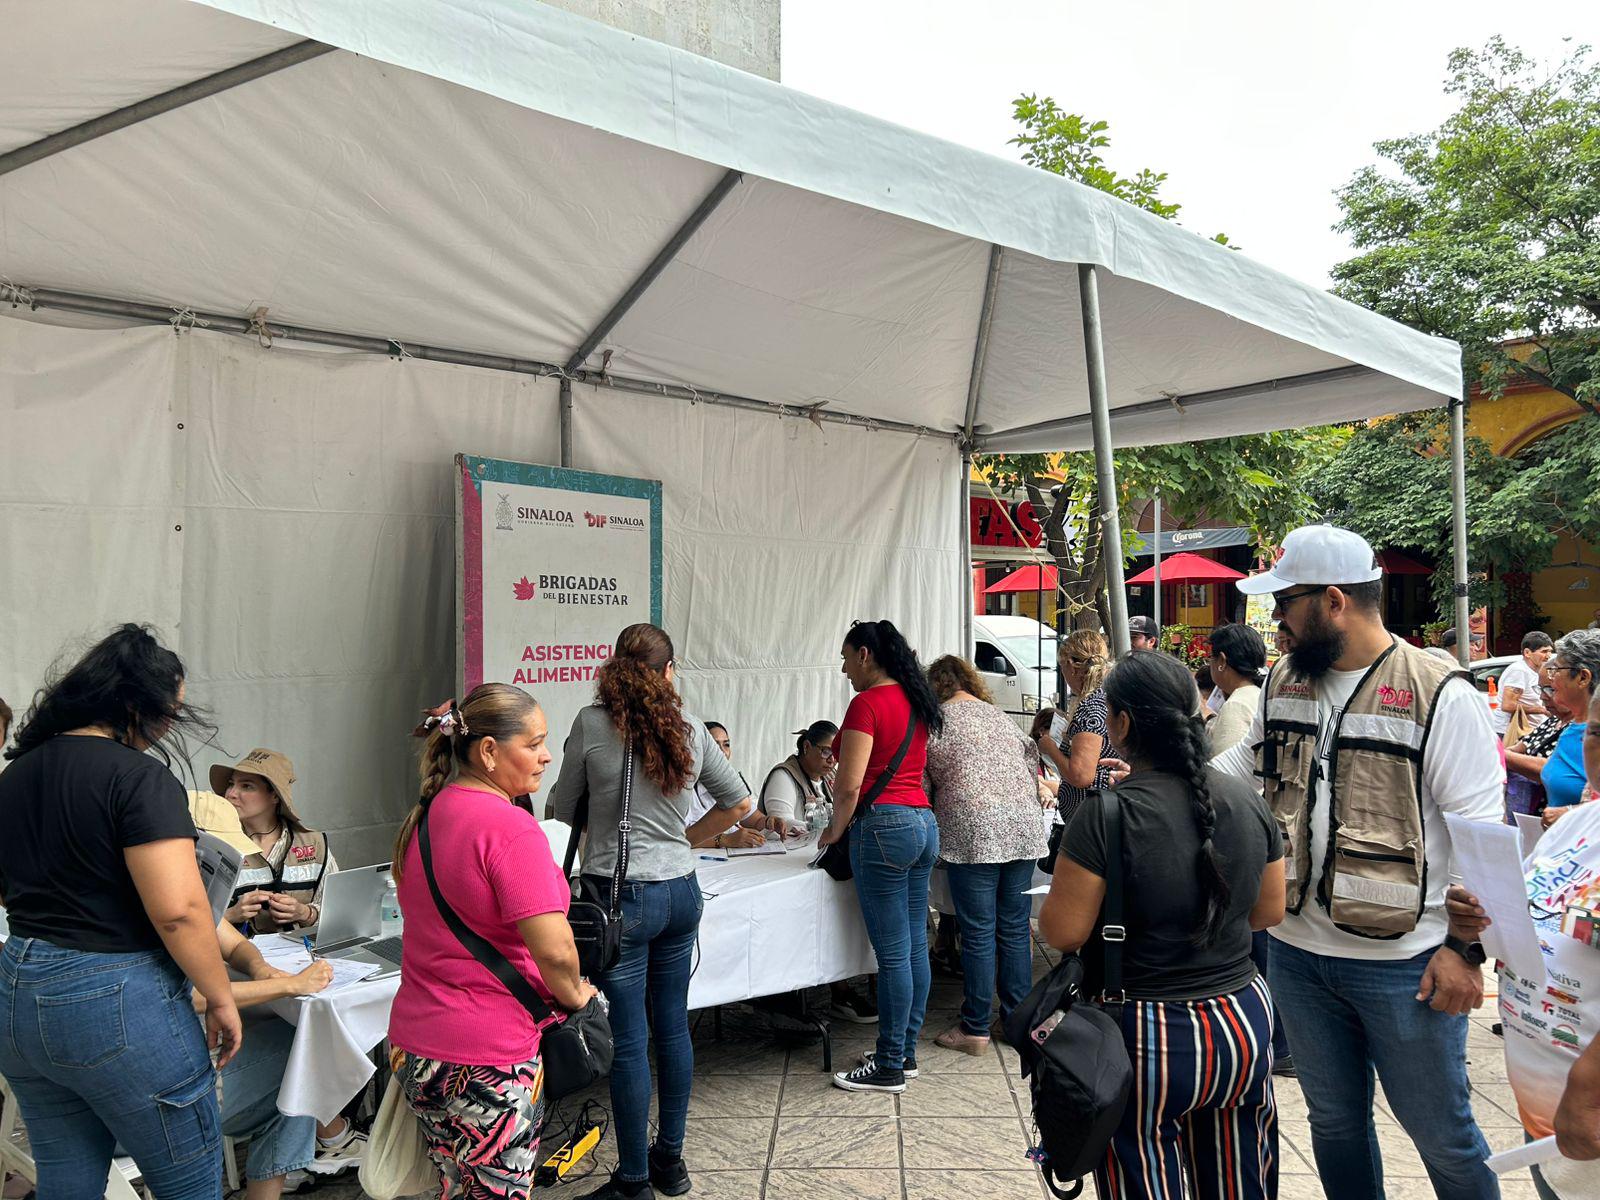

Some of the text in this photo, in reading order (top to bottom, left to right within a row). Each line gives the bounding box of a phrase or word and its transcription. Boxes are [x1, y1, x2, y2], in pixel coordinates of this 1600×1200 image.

[517, 506, 574, 523] SINALOA
[587, 514, 645, 528] DIF SINALOA
[1172, 531, 1204, 543] Corona
[539, 574, 617, 591] BRIGADAS
[543, 592, 628, 606] DEL BIENESTAR
[521, 644, 615, 661] ASISTENCI
[512, 666, 601, 684] ALIMENTA
[1381, 687, 1414, 708] DIF
[1380, 704, 1410, 715] SINALOA
